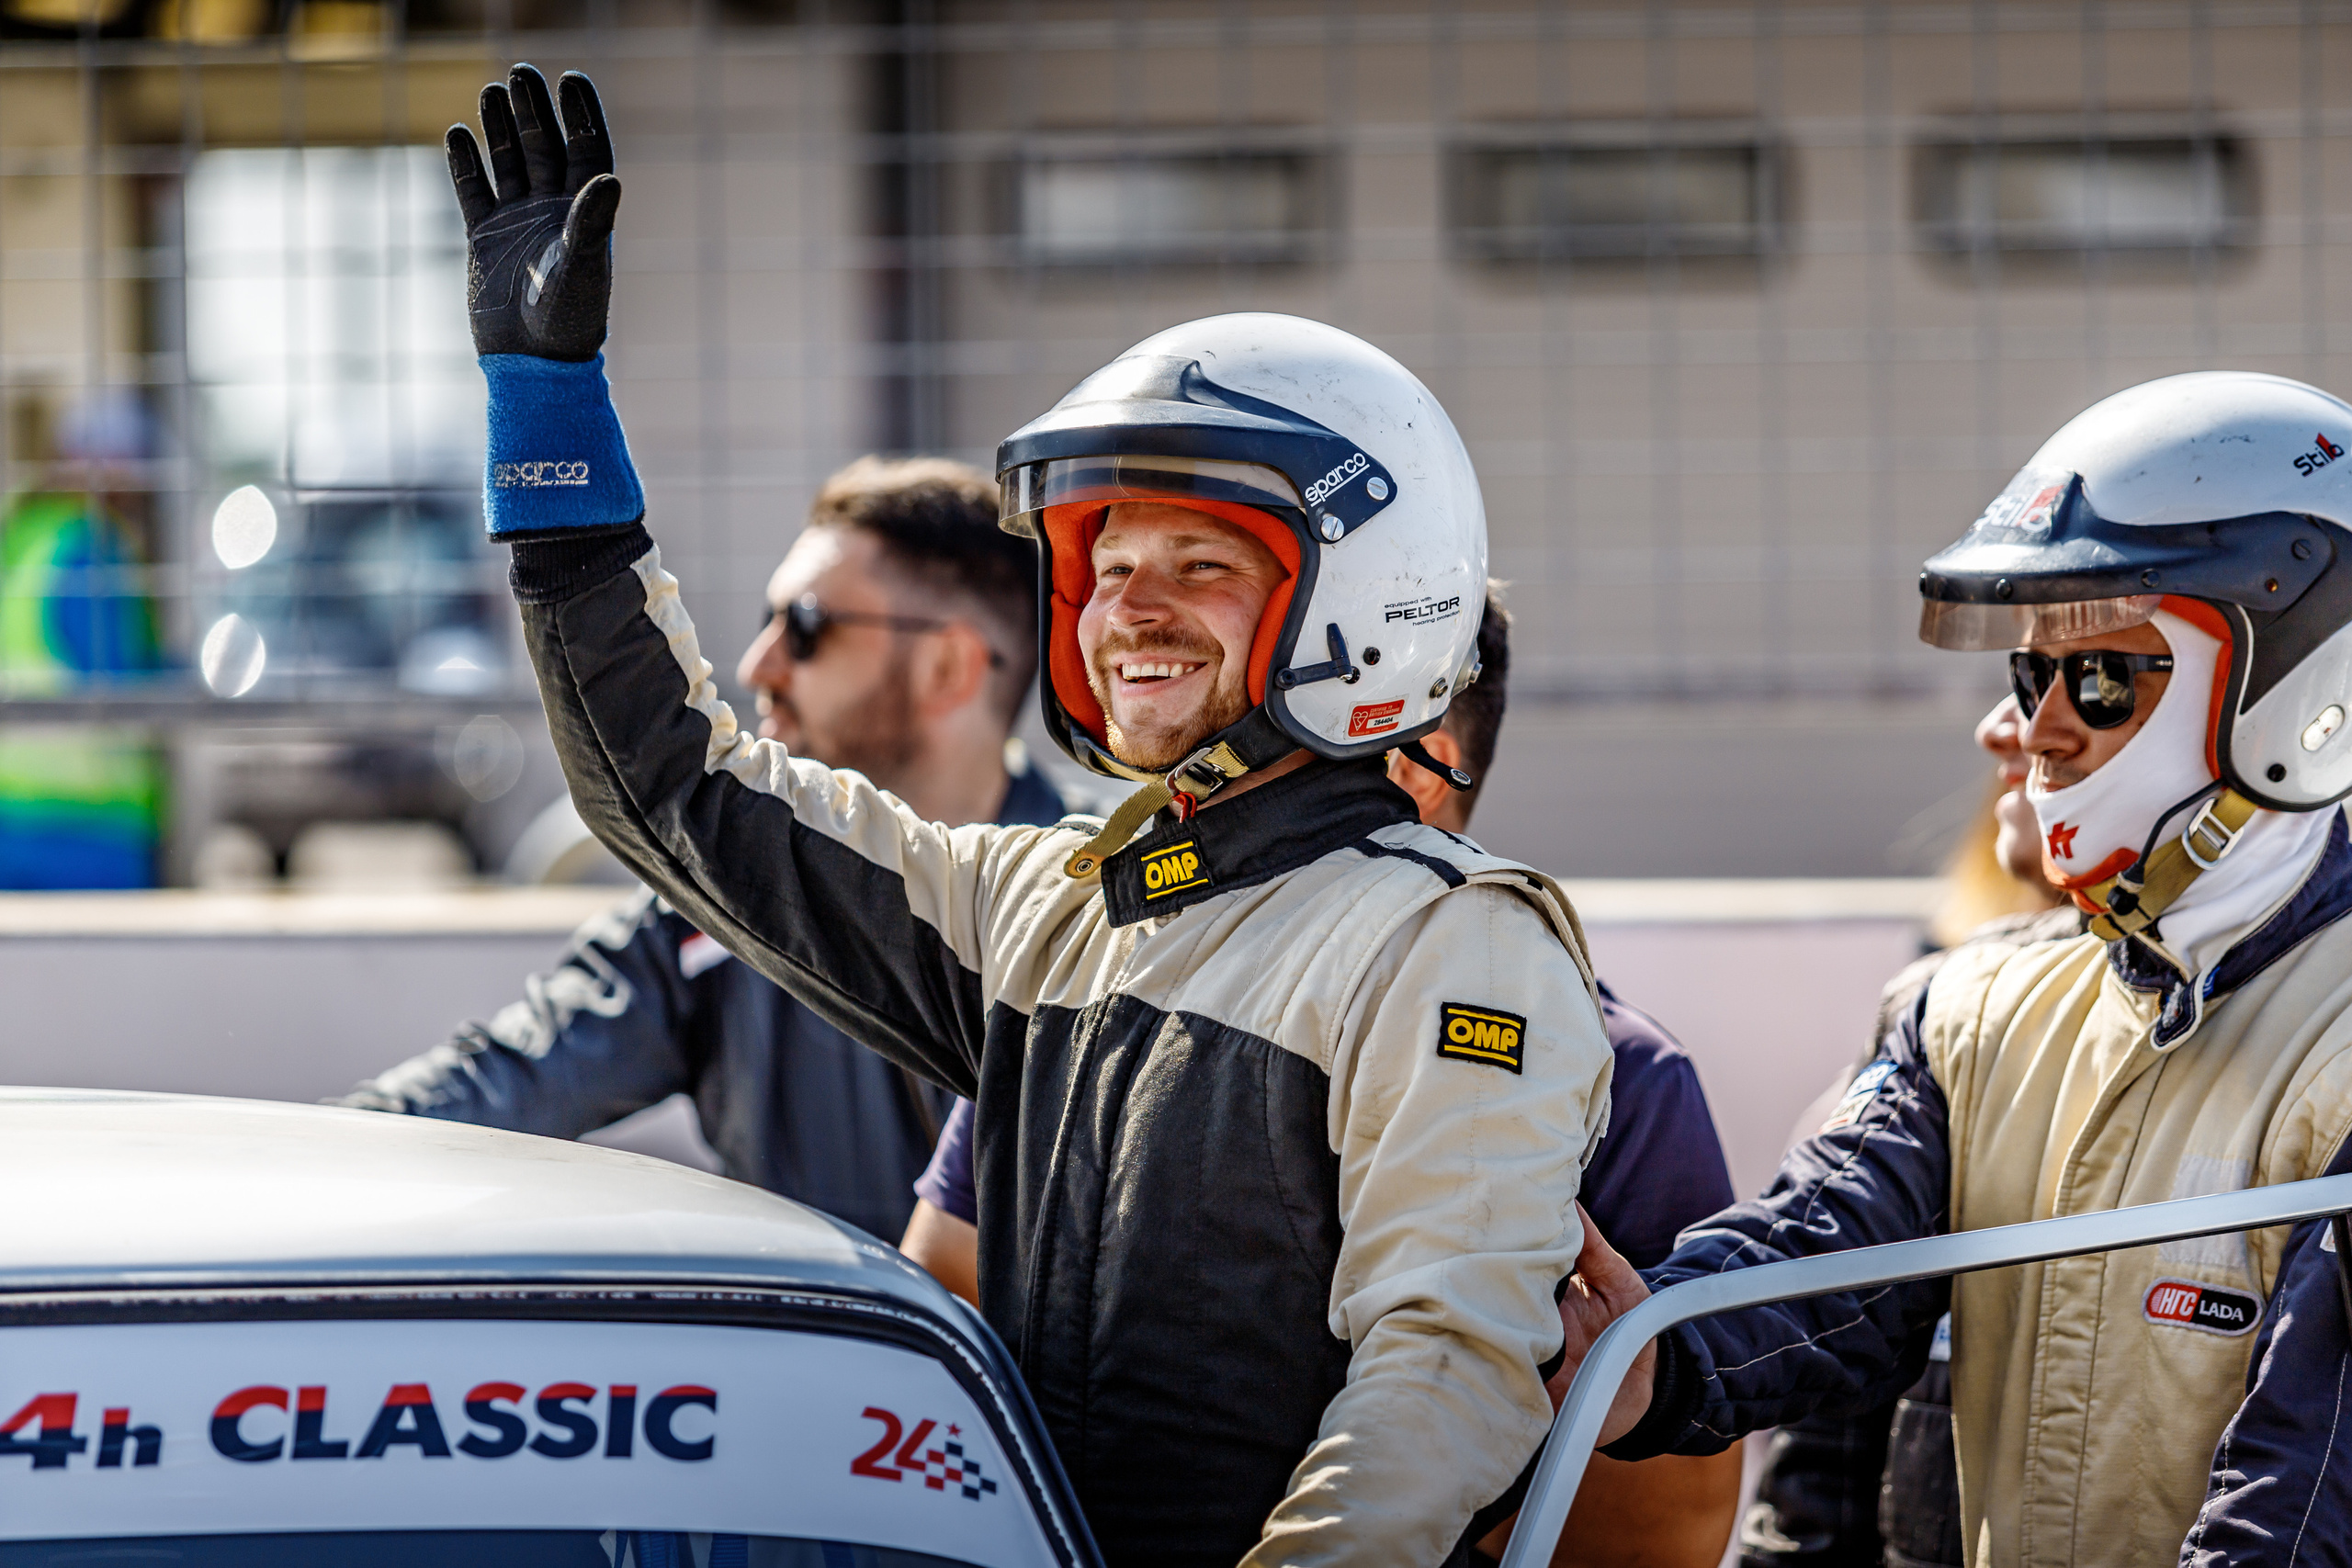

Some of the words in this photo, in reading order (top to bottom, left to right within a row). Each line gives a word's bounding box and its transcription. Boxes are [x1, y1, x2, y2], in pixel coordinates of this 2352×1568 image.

[2293, 433, 2345, 477] Stilo
[1305, 453, 1367, 502] sparco
[1384, 599, 1419, 608] equipped
[1385, 596, 1460, 623] PELTOR
[1412, 617, 1435, 626] hearing
[1145, 852, 1199, 889] OMP
[1447, 1017, 1519, 1052] OMP
[2199, 1300, 2245, 1322] LADA
[209, 1381, 718, 1463] CLASSIC
